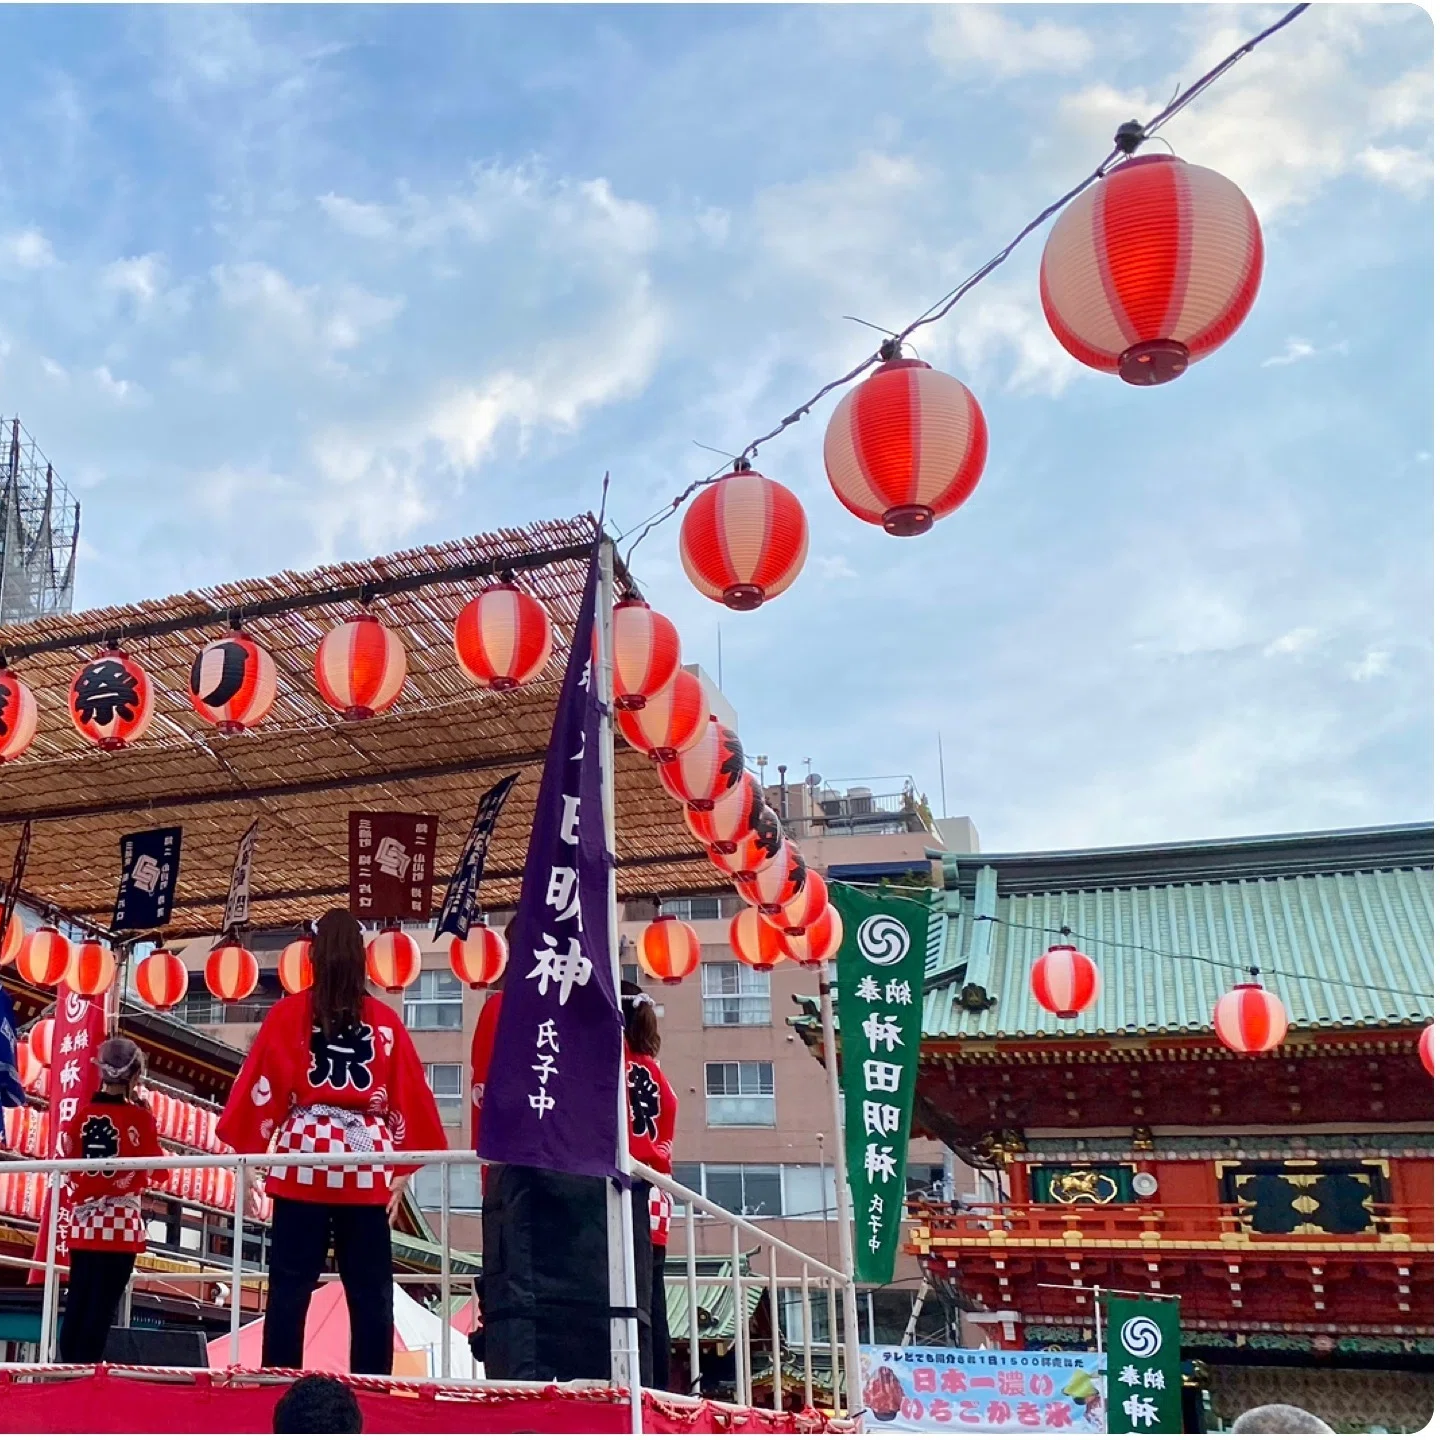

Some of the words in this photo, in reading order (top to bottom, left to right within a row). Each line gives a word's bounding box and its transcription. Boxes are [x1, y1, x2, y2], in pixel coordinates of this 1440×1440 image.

[527, 1017, 560, 1121] 氏子中
[912, 1368, 1054, 1397] 日本一濃い
[900, 1397, 1073, 1429] いちごかき氷
